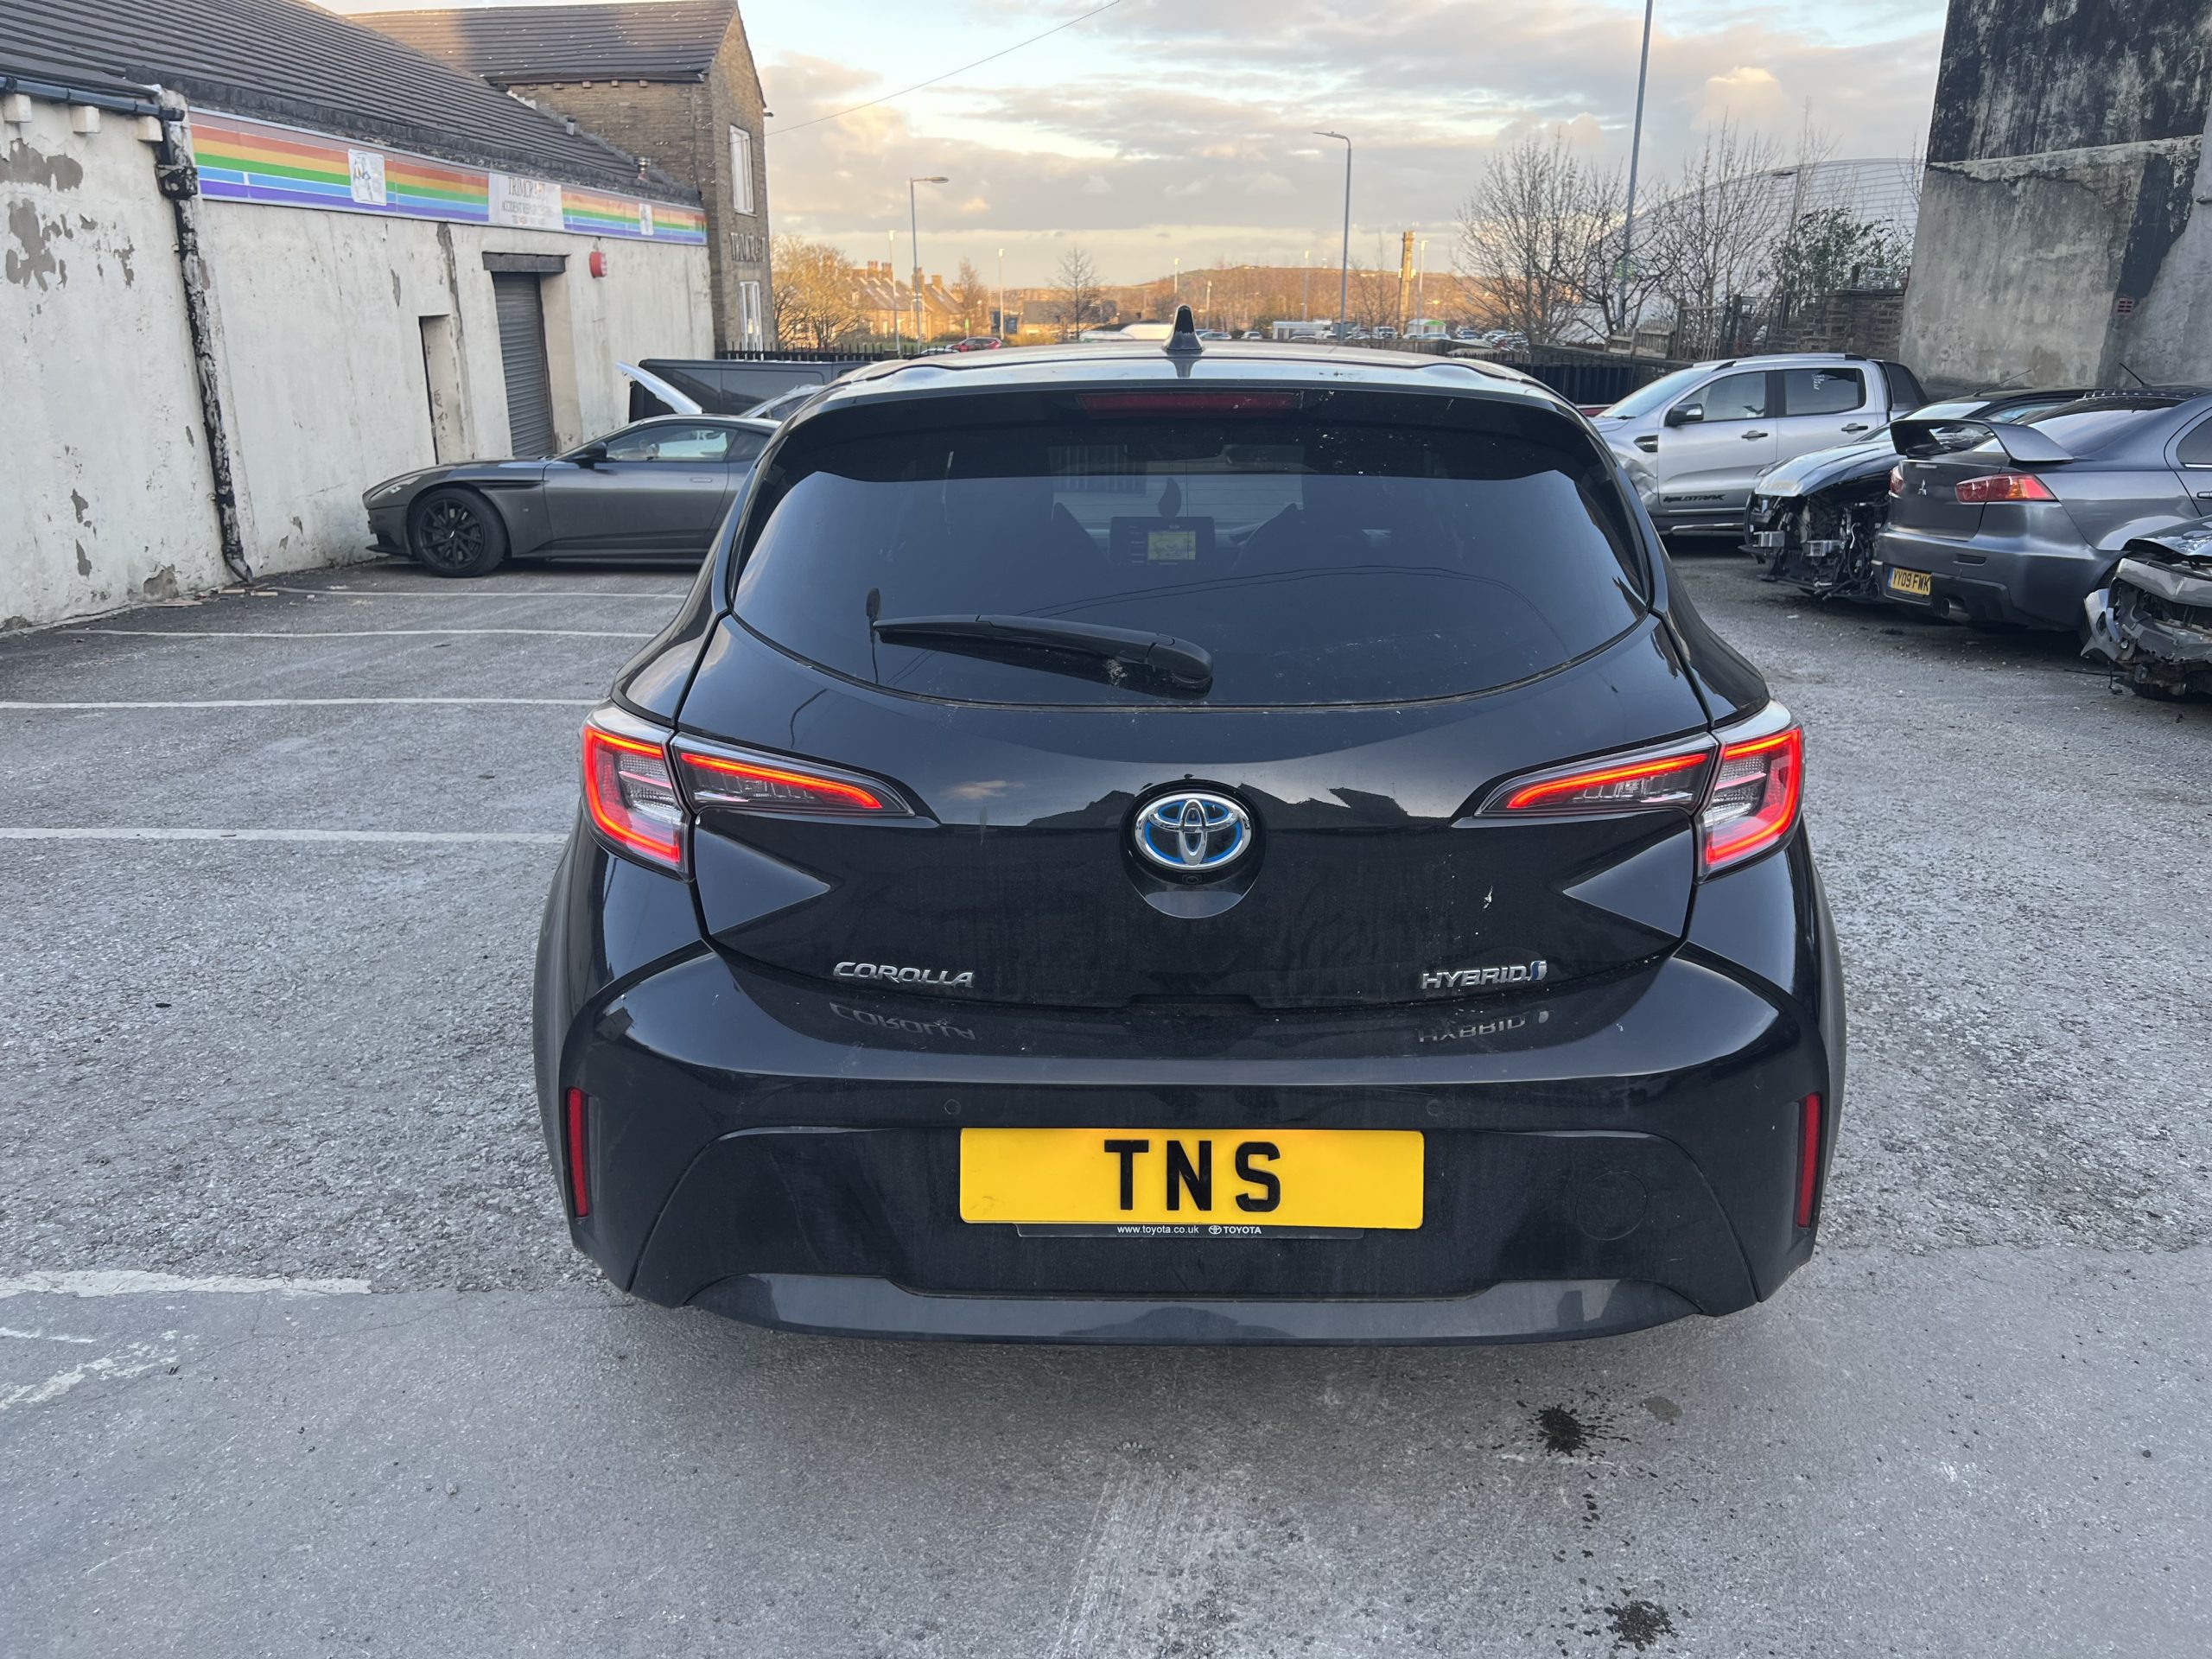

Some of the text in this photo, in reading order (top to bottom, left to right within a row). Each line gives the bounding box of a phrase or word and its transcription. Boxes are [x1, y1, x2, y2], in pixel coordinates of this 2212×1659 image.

[1893, 569, 1930, 592] YY09 FWK
[833, 962, 974, 988] COROLLA
[1104, 1140, 1281, 1212] TNS
[1117, 1224, 1262, 1236] www.toyota.co.uk TOYOTA
